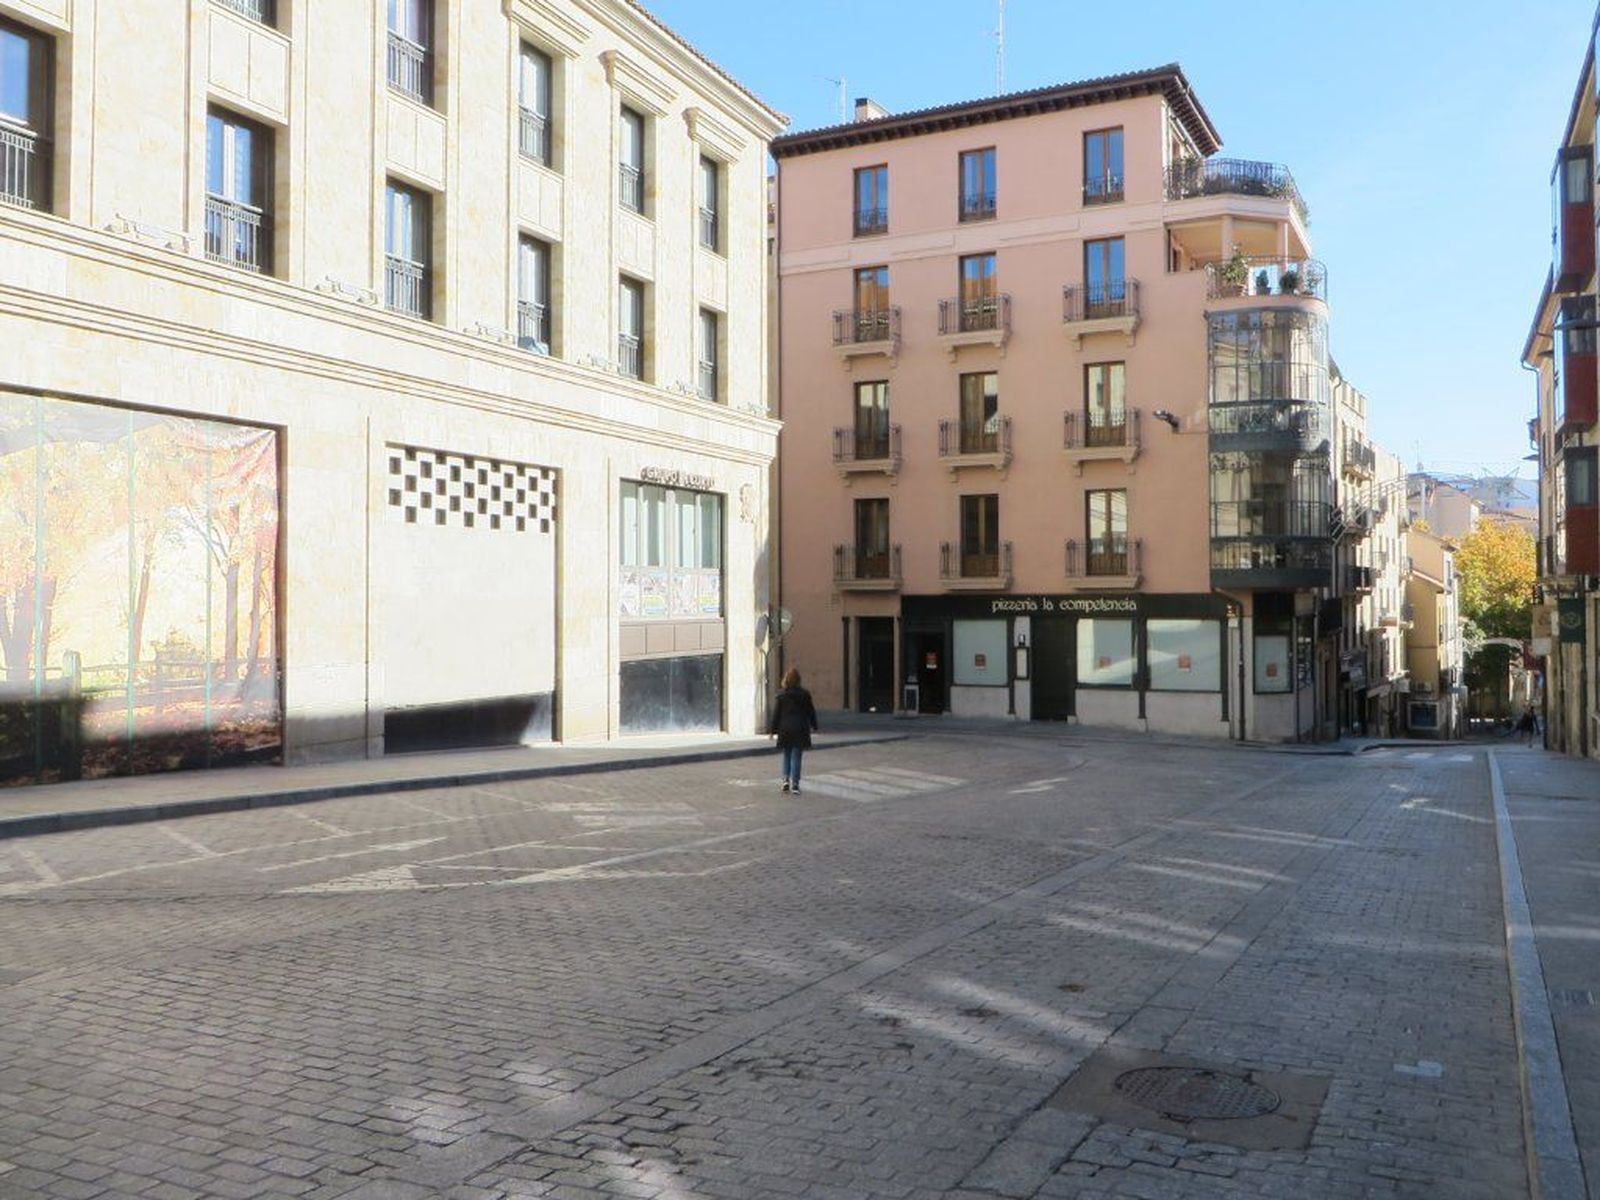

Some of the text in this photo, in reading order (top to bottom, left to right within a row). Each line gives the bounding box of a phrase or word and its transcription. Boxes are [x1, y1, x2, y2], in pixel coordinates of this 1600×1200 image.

[991, 597, 1137, 613] pizzeria la competencia
